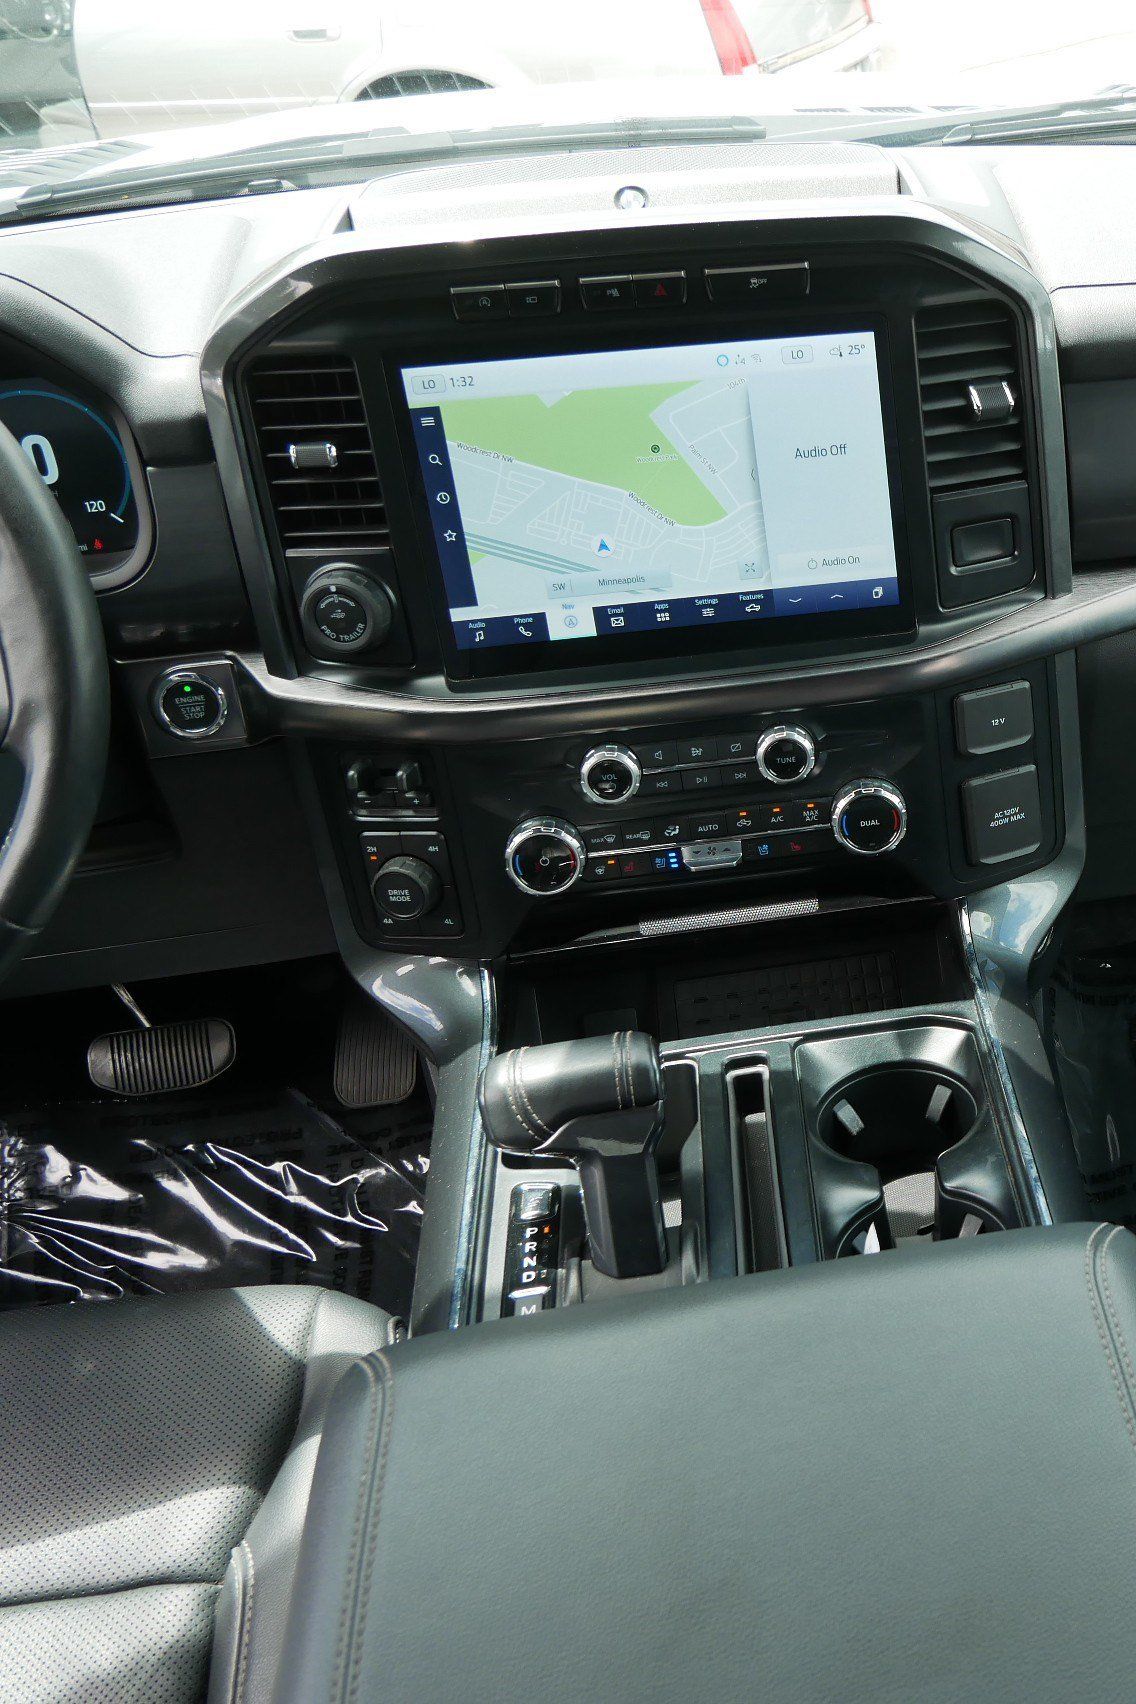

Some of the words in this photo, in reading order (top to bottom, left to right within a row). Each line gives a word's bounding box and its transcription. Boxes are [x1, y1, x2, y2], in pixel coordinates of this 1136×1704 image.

[791, 350, 804, 360] LO
[848, 344, 866, 356] 25°
[422, 379, 436, 390] LO
[449, 375, 475, 388] 1:32
[728, 377, 746, 390] 104th
[456, 441, 493, 459] Woodcrest
[493, 451, 502, 460] Dr
[502, 453, 515, 464] NW
[794, 446, 828, 460] Audio
[829, 444, 847, 456] Off
[21, 434, 59, 485] 0
[688, 444, 703, 461] Palm
[706, 463, 719, 476] NW
[84, 500, 106, 513] 120
[627, 490, 658, 518] Woodcrest
[656, 512, 665, 521] Dr
[663, 517, 677, 528] NW
[822, 556, 847, 568] Audio
[848, 555, 861, 565] On
[598, 574, 646, 588] Minneapolis
[552, 583, 566, 592] SW
[694, 597, 719, 607] Settings
[739, 592, 764, 602] Features
[561, 603, 575, 611] Nav
[607, 607, 625, 615] Email
[654, 602, 669, 611] Apps
[468, 621, 486, 629] Audio
[513, 616, 533, 625] Phone
[321, 625, 336, 639] PRO
[339, 622, 365, 641] TRAILER
[175, 694, 206, 705] ENGINE
[181, 705, 205, 715] START
[184, 711, 205, 721] STOP
[776, 756, 796, 765] TUNE
[771, 815, 784, 823] A/C
[803, 809, 819, 818] MAX
[994, 810, 1004, 820] AC
[1004, 806, 1020, 817] 120V
[860, 819, 881, 828] DUAL
[989, 816, 1009, 828] 400W
[1010, 811, 1026, 822] MAX
[698, 823, 719, 833] AUTO
[525, 1227, 539, 1239] P
[524, 1241, 537, 1253] R
[522, 1255, 537, 1268] N
[522, 1270, 536, 1283] D
[521, 1304, 537, 1316] M
